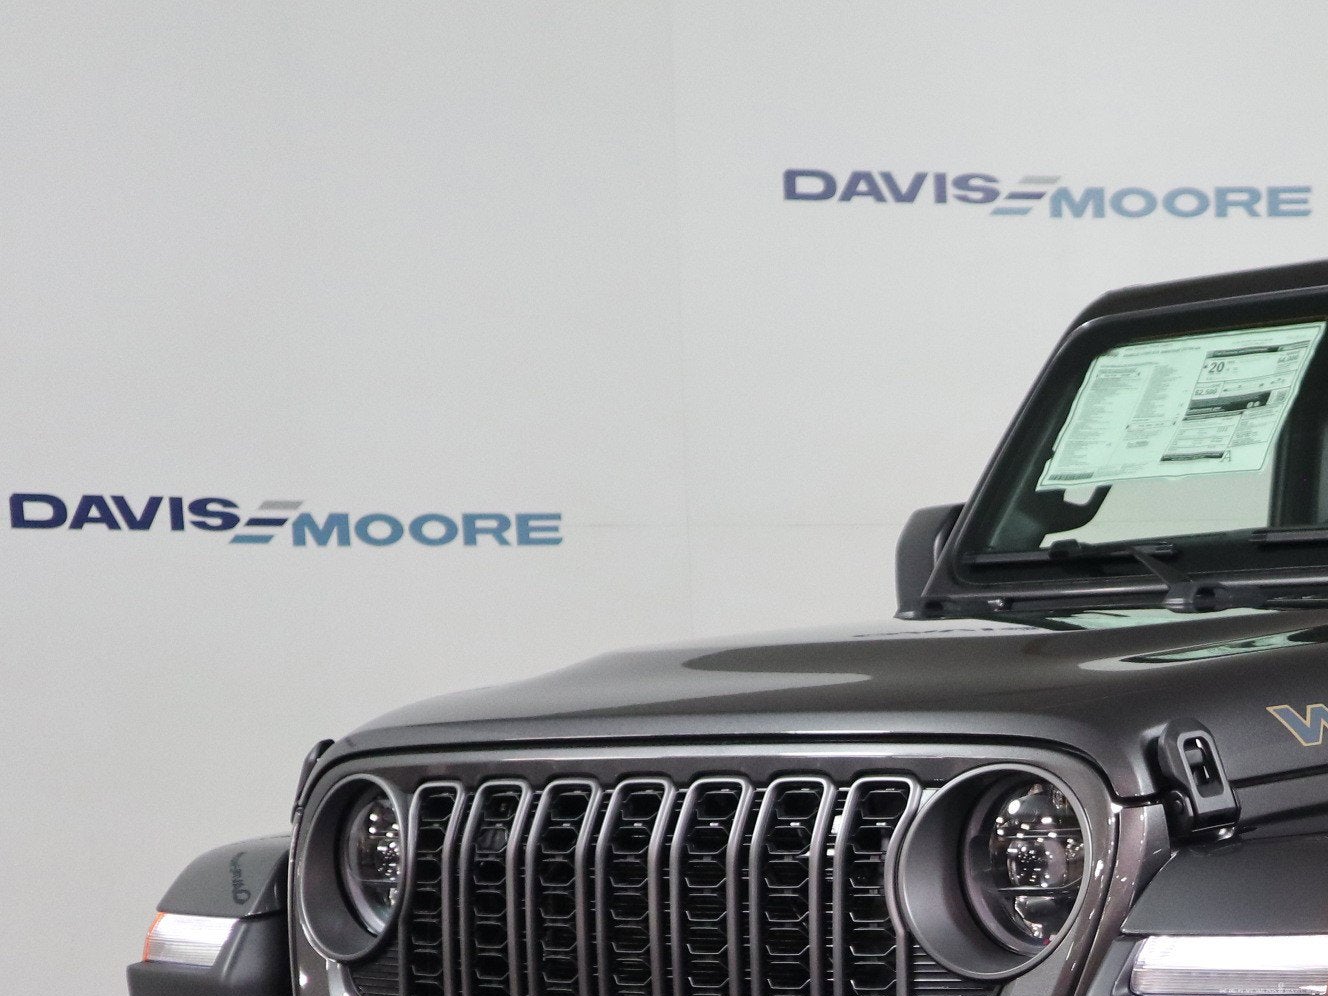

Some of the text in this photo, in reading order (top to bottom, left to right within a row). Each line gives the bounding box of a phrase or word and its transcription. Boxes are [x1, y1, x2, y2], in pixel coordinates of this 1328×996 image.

[783, 168, 1313, 219] DAVIS MOORE
[1208, 361, 1226, 374] 20
[9, 493, 563, 547] DAVIS MOORE
